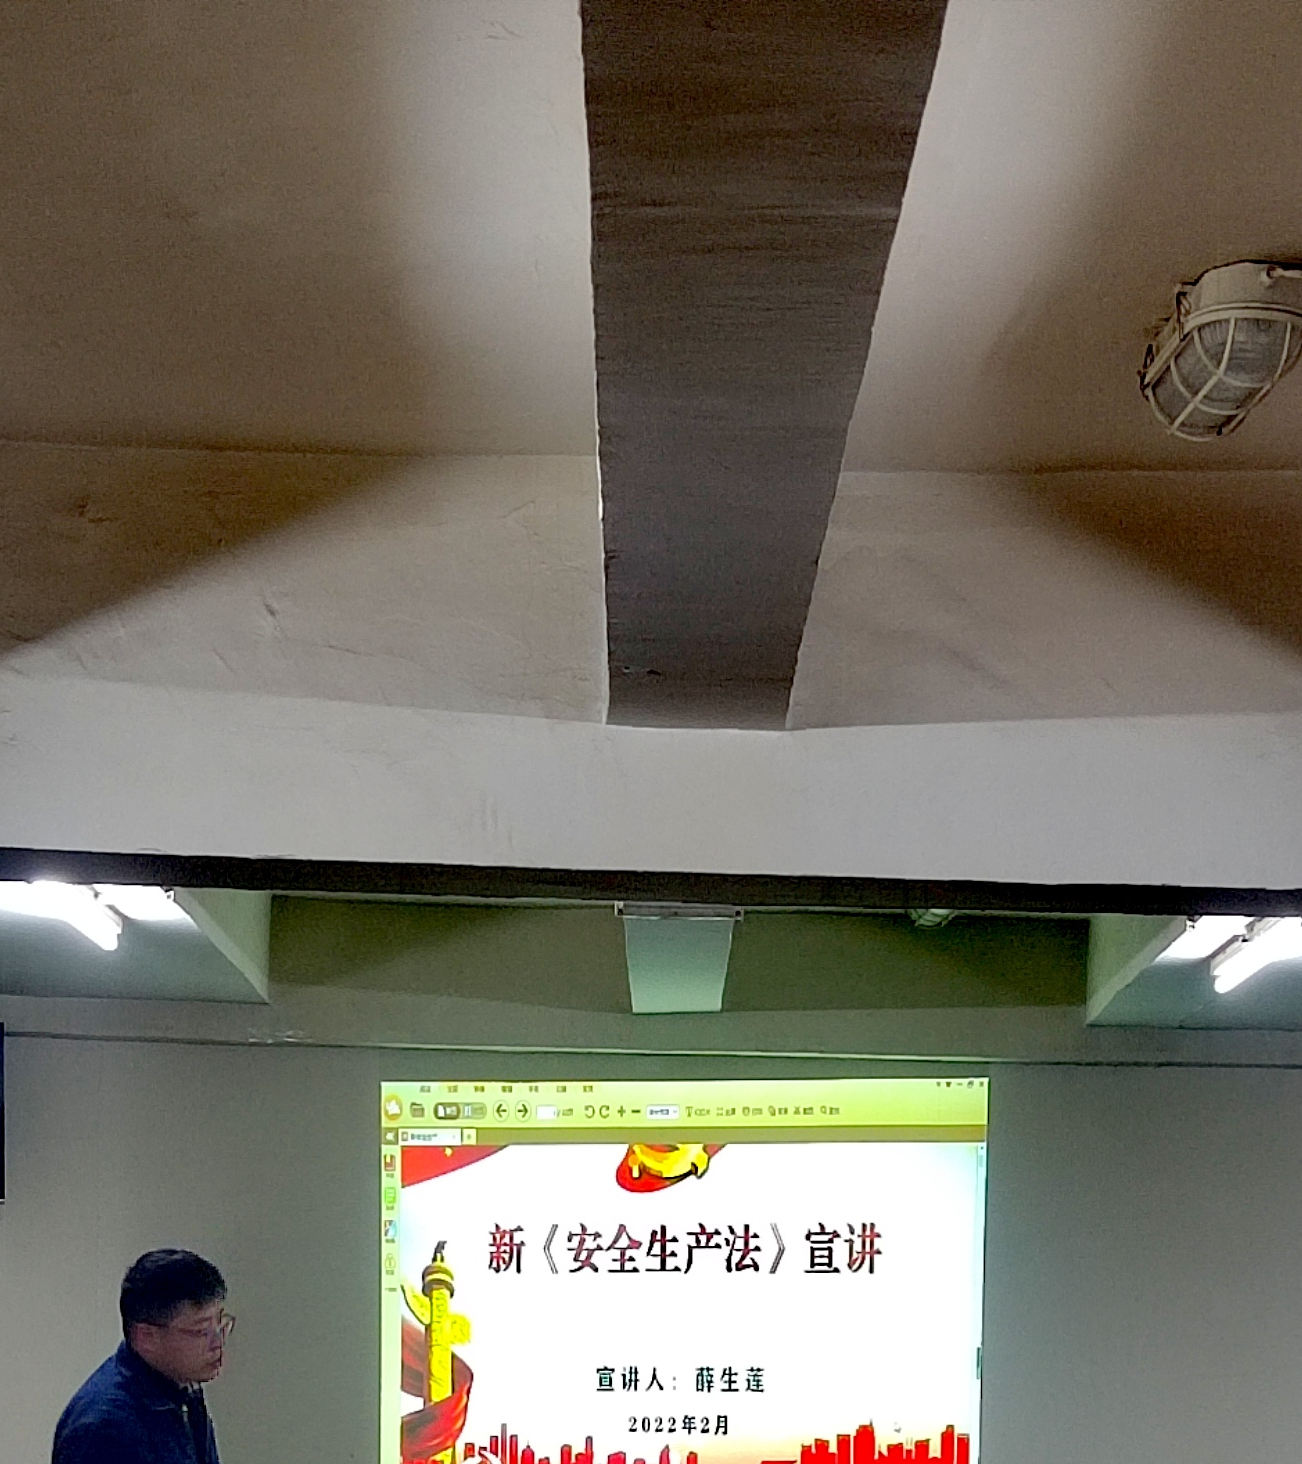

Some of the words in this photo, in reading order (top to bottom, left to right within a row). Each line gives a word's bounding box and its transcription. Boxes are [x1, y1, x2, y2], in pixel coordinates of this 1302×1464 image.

[487, 1221, 883, 1275] 新《安全生产法》宣讲
[628, 1414, 730, 1436] 2022年2月
